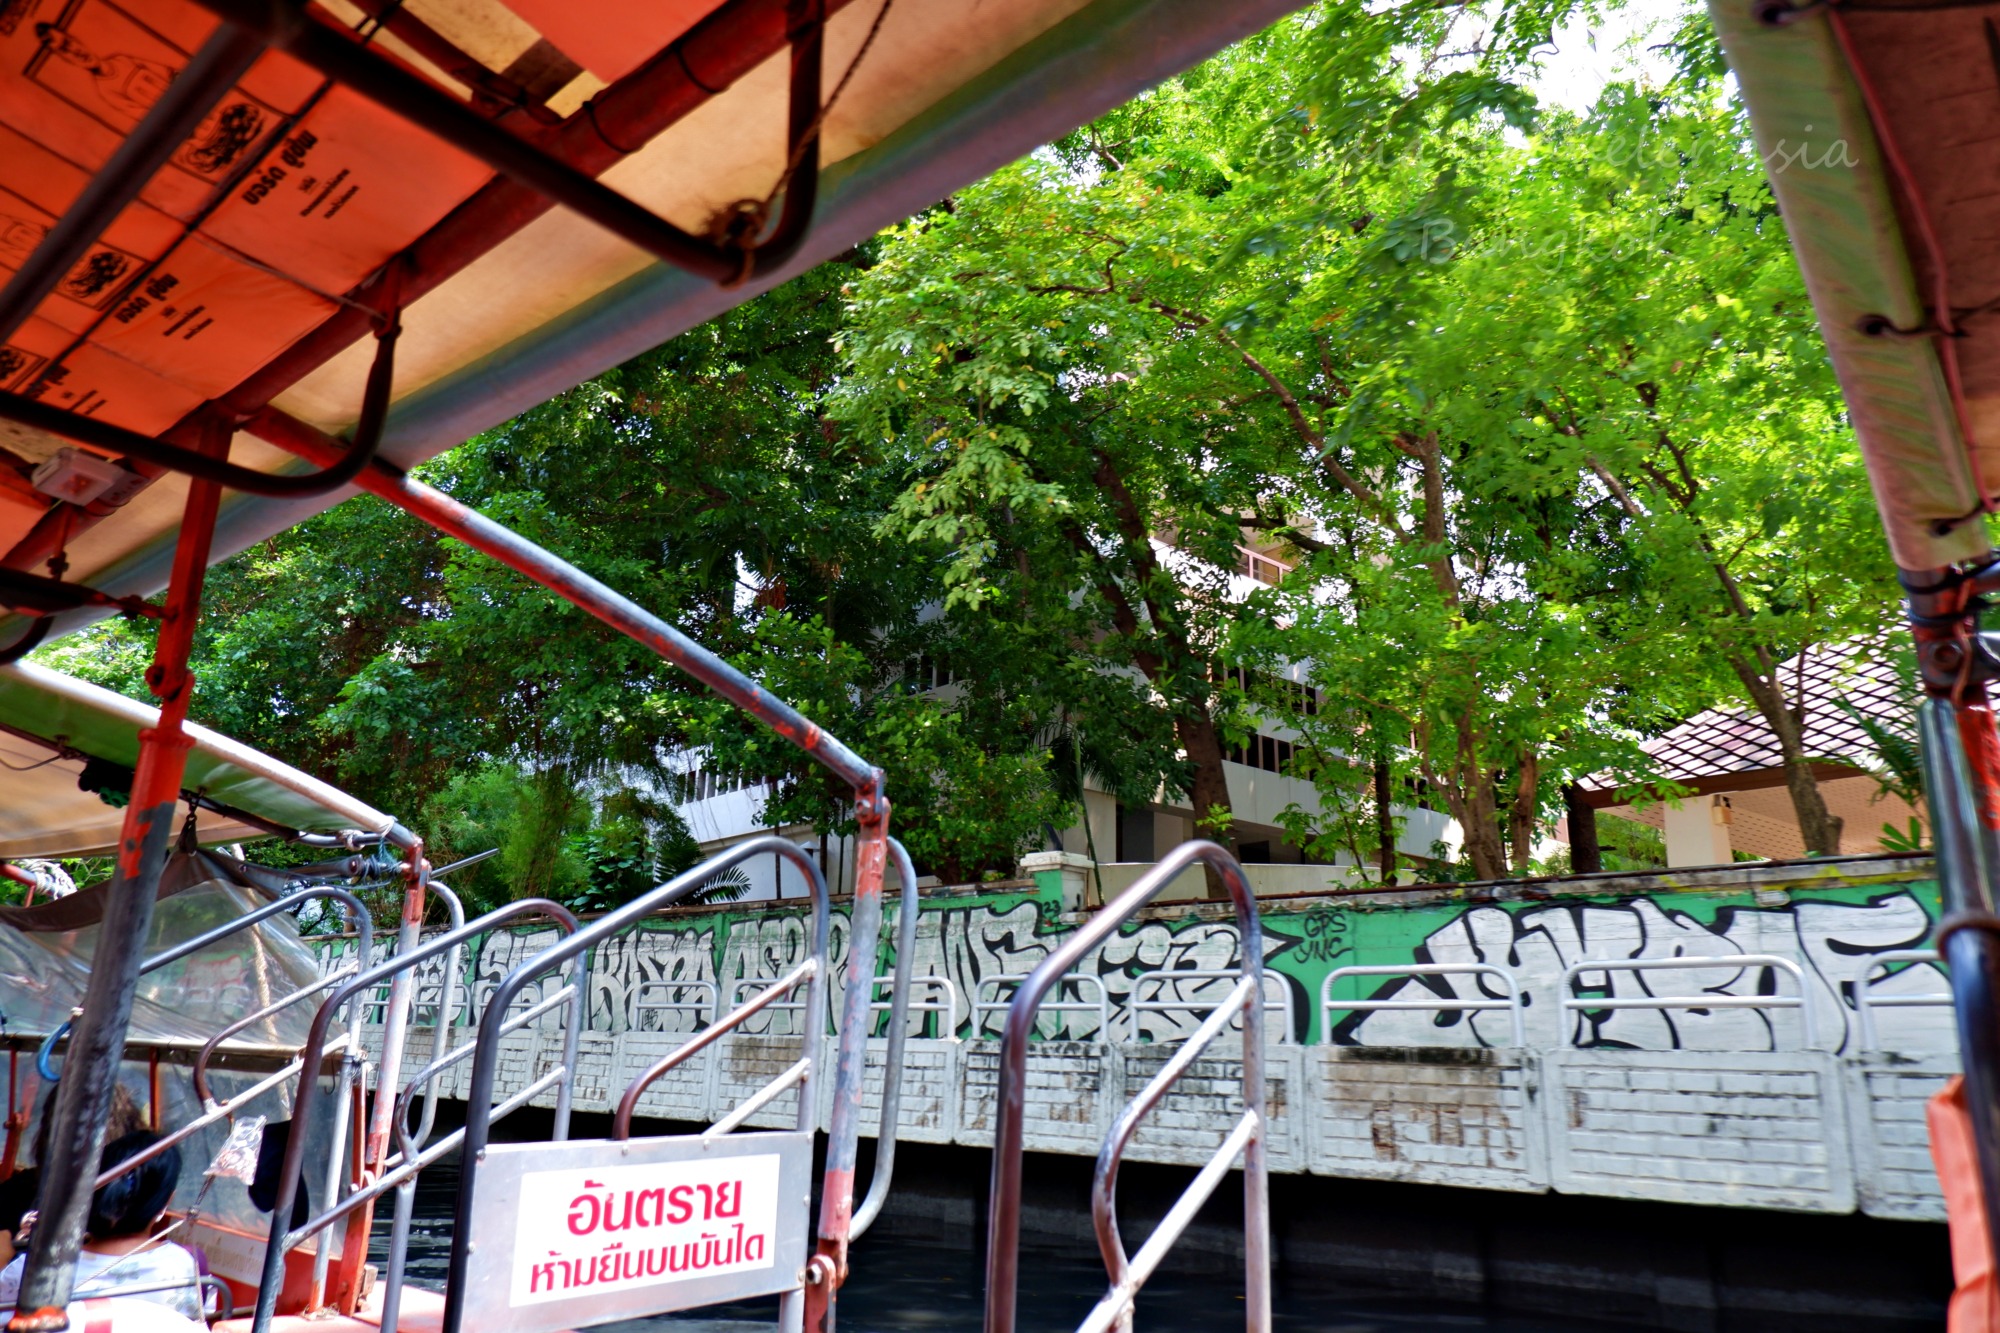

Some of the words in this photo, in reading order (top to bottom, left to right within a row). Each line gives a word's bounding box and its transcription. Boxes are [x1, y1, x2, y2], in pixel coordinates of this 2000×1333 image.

[1304, 912, 1348, 938] GPS
[1293, 936, 1356, 964] YNC
[567, 1179, 743, 1236] อันตราย
[529, 1223, 765, 1293] ห้ามยืนบนบันได
